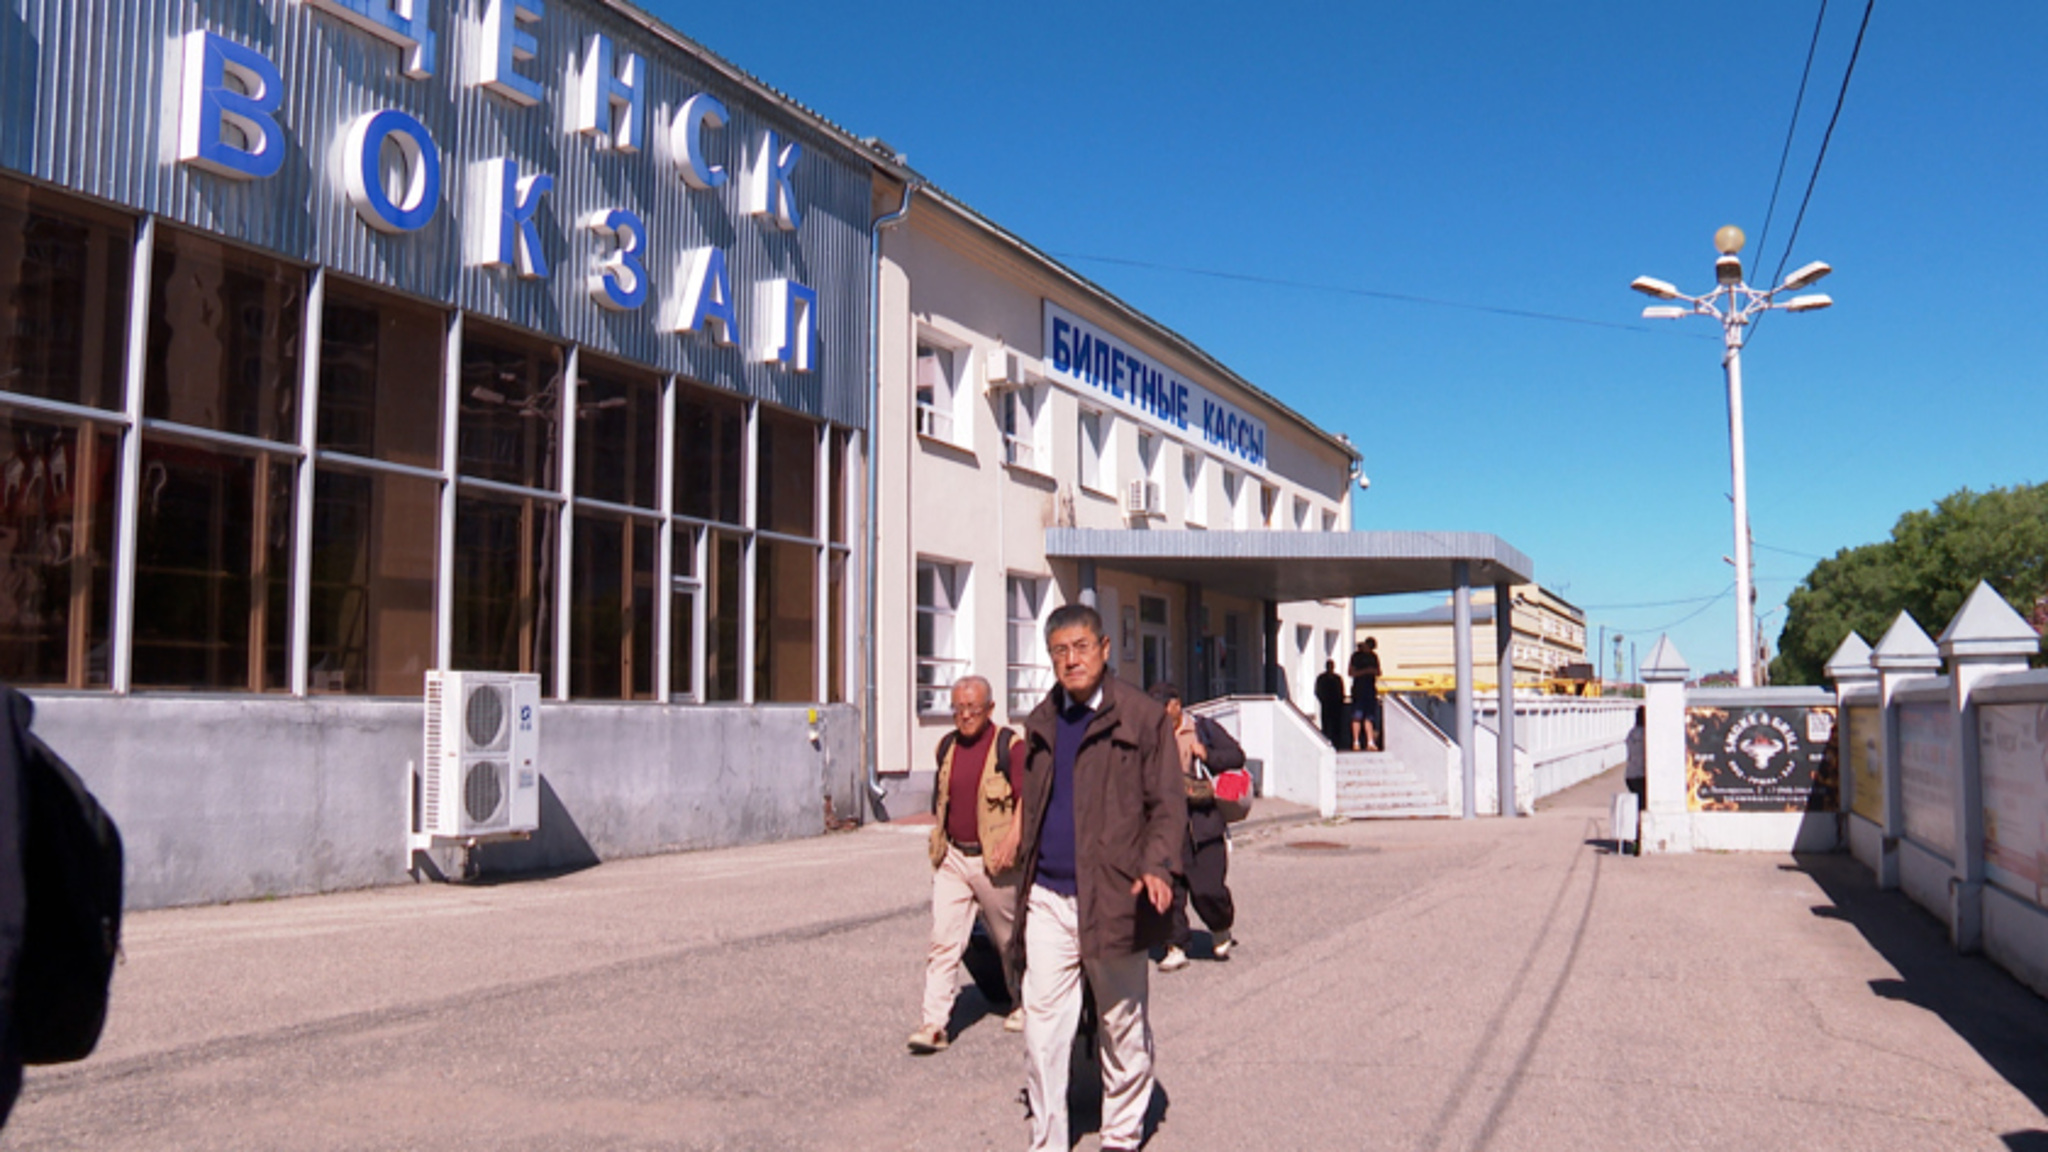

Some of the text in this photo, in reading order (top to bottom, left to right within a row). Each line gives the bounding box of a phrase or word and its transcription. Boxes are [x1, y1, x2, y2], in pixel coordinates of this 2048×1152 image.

[181, 28, 817, 372] ВОКЗАЛ
[1053, 316, 1264, 467] БИЛЕТНЫЕ КАССЫ
